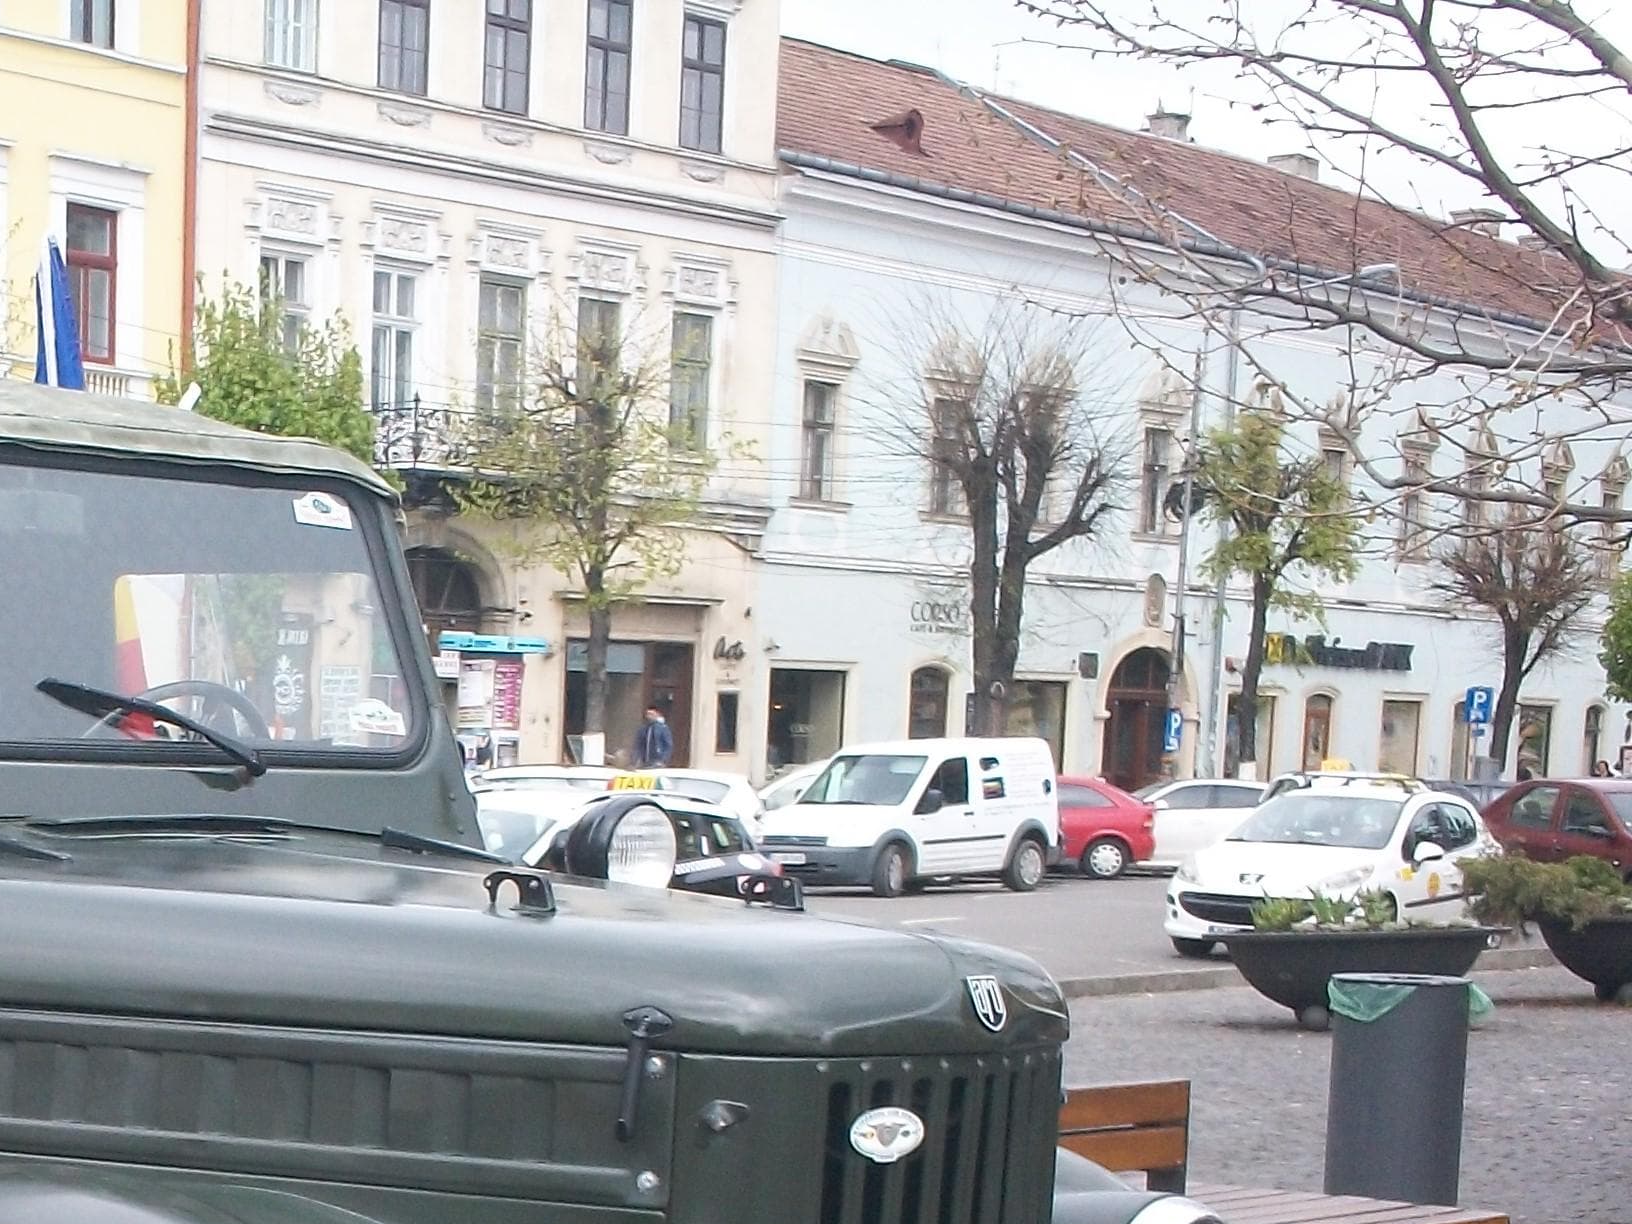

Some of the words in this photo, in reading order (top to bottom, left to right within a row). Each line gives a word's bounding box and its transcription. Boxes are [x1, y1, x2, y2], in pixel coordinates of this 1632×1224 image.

[1473, 690, 1487, 709] P
[1171, 711, 1181, 737] P
[618, 776, 653, 790] TAXI
